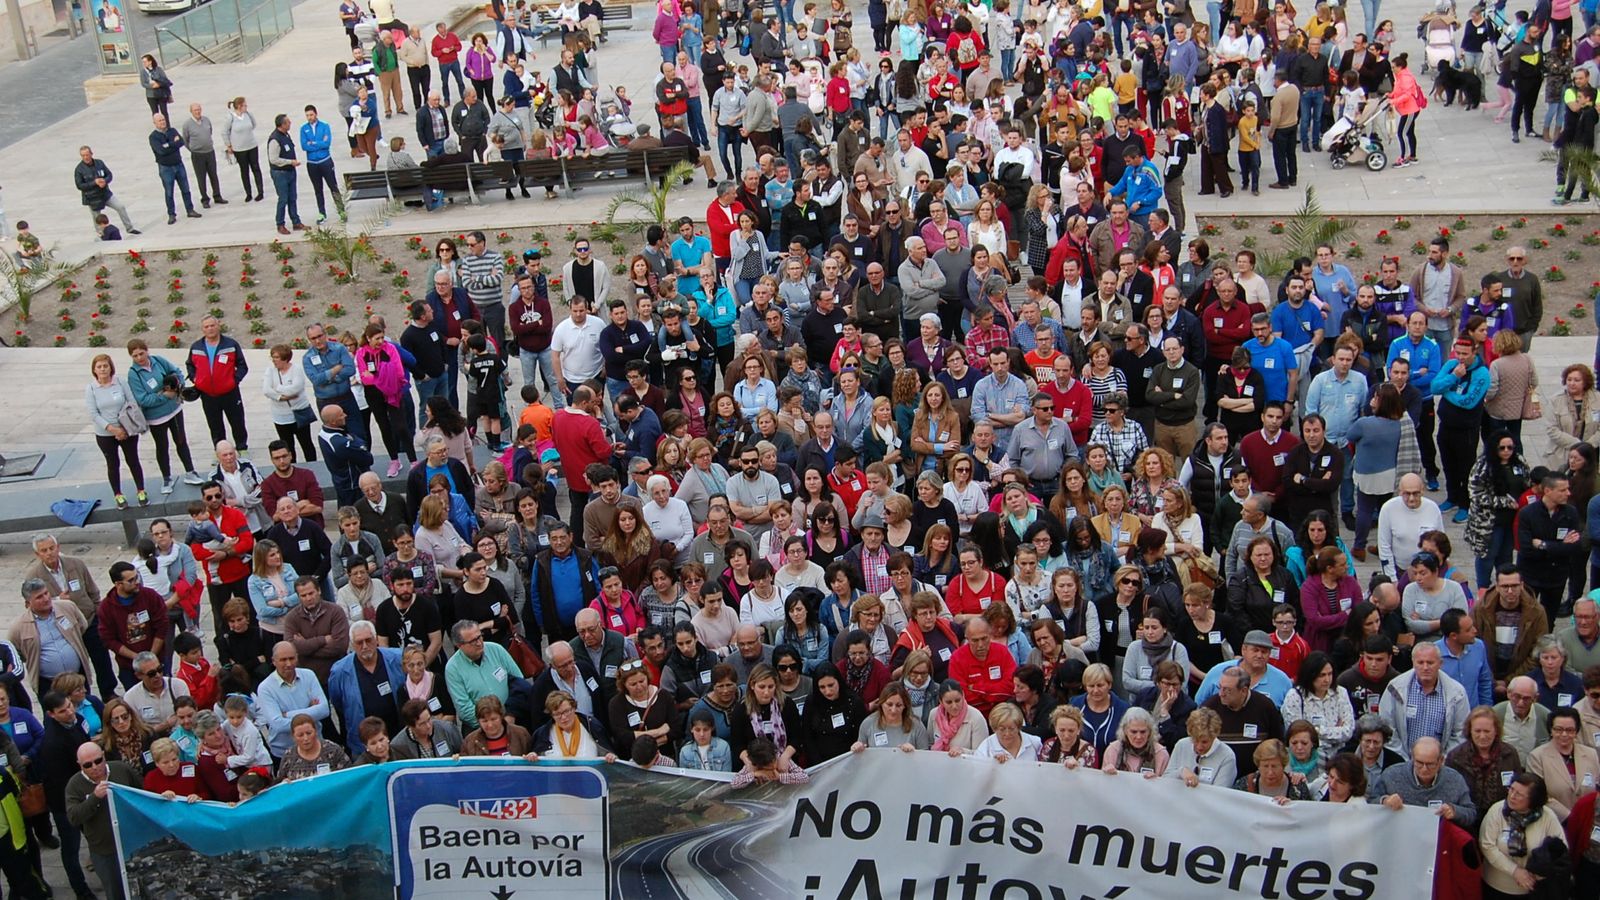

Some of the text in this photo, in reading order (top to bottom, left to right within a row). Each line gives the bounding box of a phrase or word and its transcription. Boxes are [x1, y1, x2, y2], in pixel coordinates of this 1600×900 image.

[480, 368, 489, 388] 7
[462, 799, 533, 819] N-432
[419, 825, 585, 851] Baena por
[789, 789, 882, 841] No
[905, 796, 1044, 855] más
[1068, 824, 1379, 900] muertes
[424, 854, 582, 881] la Autovía
